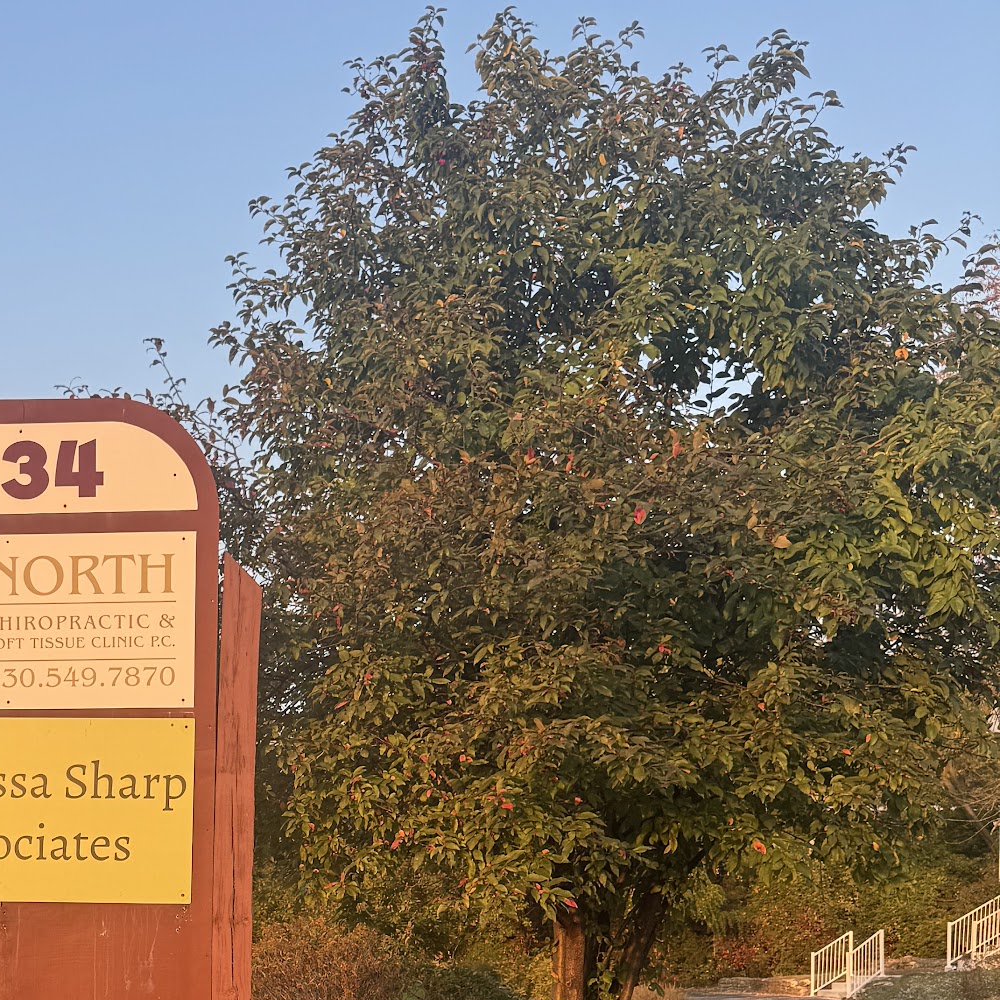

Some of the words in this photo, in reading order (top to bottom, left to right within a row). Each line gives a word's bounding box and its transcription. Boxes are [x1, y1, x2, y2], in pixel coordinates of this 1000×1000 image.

[159, 614, 175, 629] &
[31, 637, 85, 649] TISSUE
[91, 635, 145, 648] CLINIC
[151, 635, 176, 648] P.C.
[65, 760, 188, 811] Sharp
